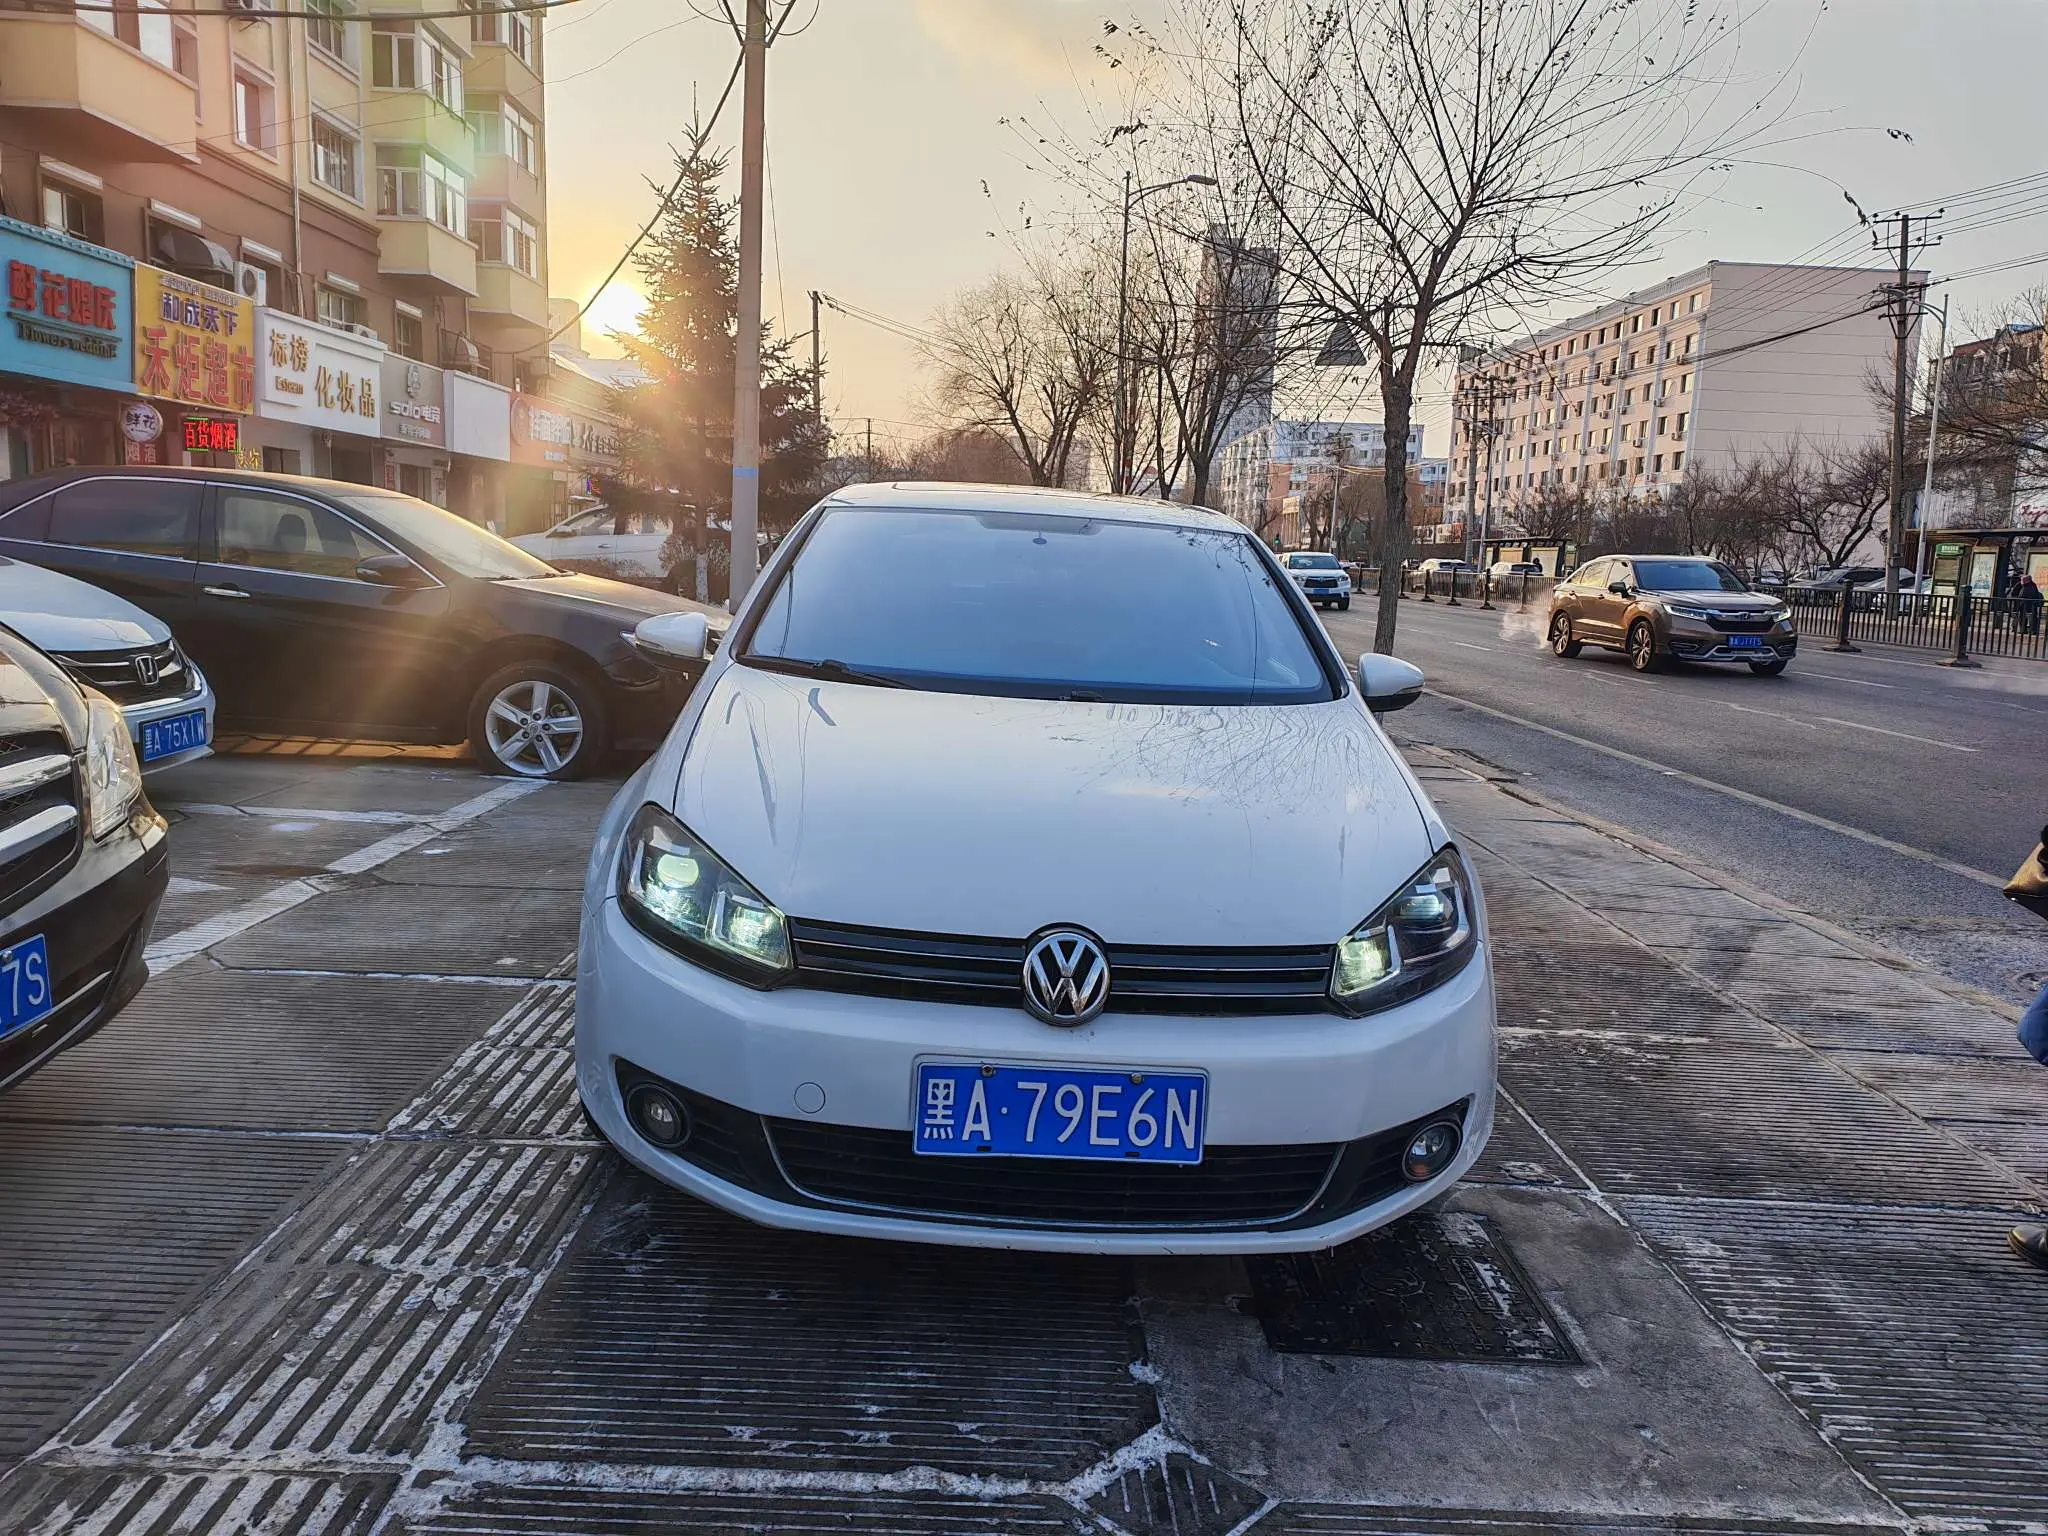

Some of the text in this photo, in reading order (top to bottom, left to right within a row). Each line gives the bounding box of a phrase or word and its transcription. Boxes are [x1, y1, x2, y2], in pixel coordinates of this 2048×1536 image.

[162, 291, 239, 337] 和成天下
[269, 328, 309, 372] 标榜
[315, 365, 376, 418] 化妆品
[183, 420, 237, 449] 百货烟酒
